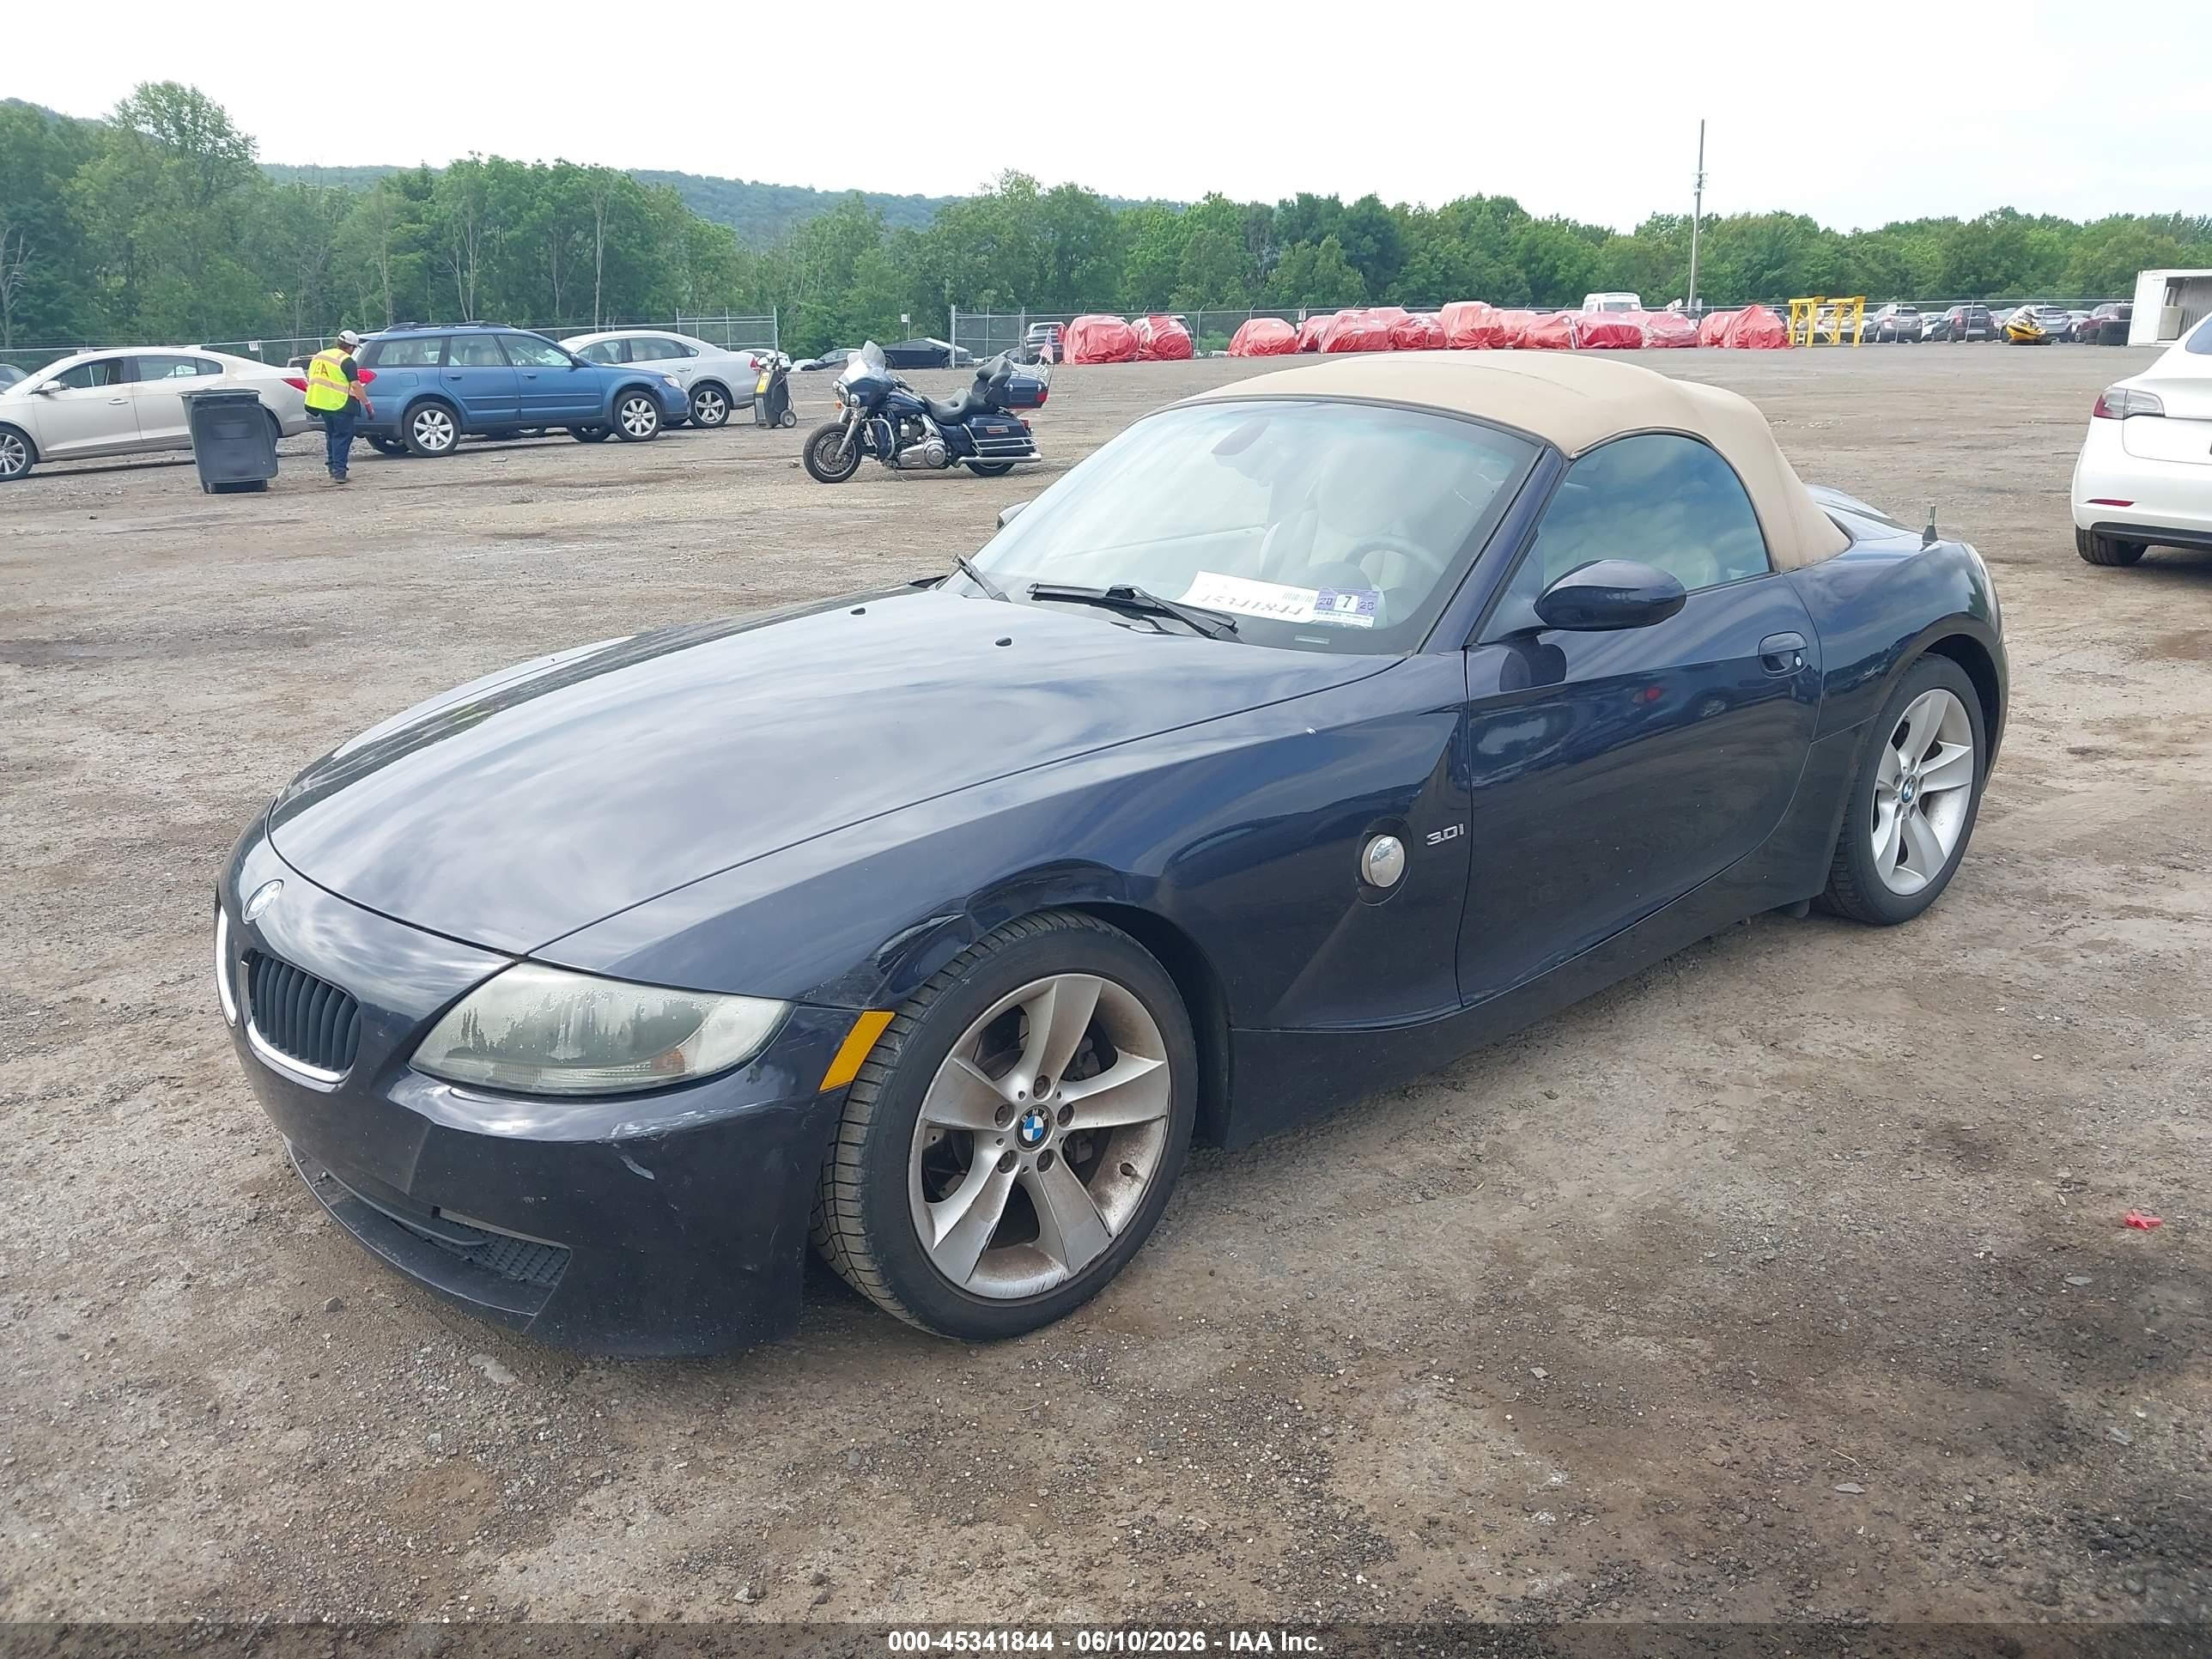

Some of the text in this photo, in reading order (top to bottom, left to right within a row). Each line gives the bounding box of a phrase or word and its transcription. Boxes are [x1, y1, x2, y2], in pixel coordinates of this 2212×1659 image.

[1318, 597, 1334, 605] 20
[1342, 595, 1352, 608] 7
[1021, 1109, 1048, 1122] BMW
